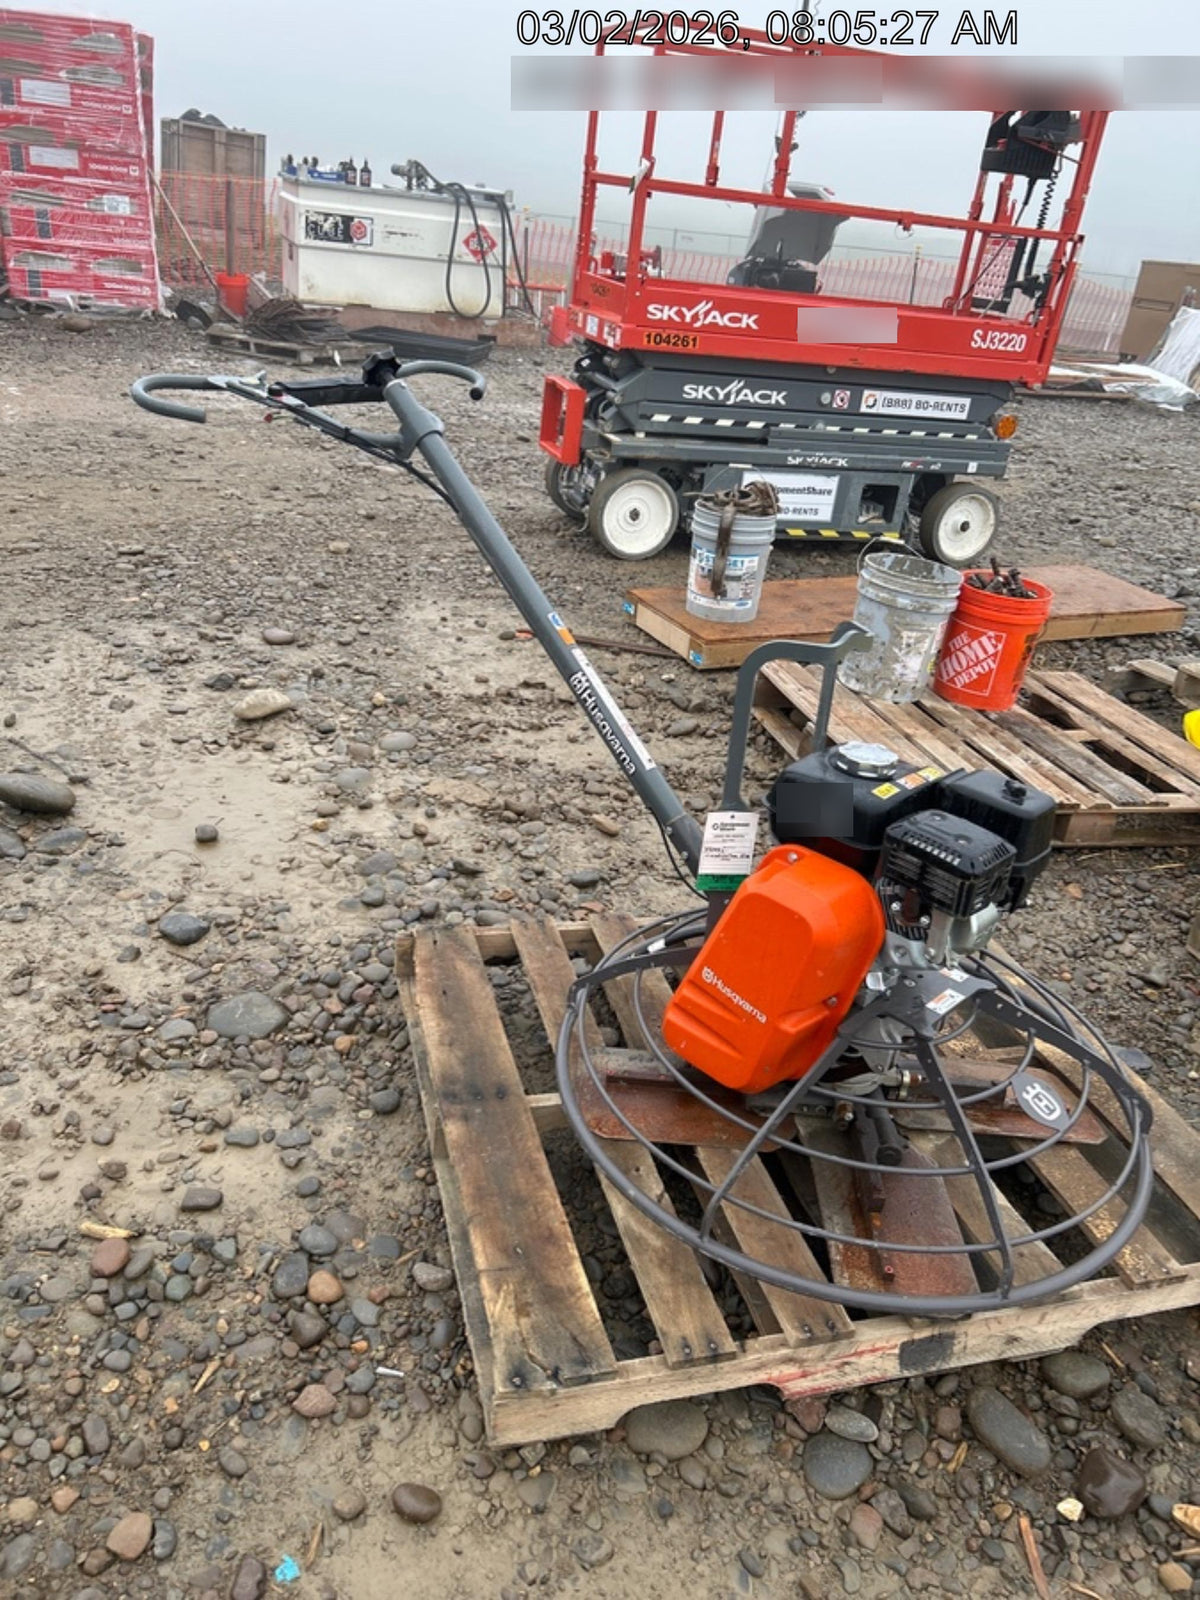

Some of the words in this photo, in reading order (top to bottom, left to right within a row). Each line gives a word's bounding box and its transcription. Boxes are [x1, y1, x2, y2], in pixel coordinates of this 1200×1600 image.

[646, 300, 759, 330] SKYJACK
[645, 332, 698, 348] 104261
[970, 328, 1027, 352] SJ3220
[682, 379, 787, 405] SKYJACK
[915, 400, 967, 413] 80-RENTS
[949, 631, 971, 653] THE
[940, 632, 1002, 682] HOME
[954, 656, 996, 688] DEPOT
[580, 689, 636, 775] Husqvarna
[711, 977, 768, 1025] Husqvarna
